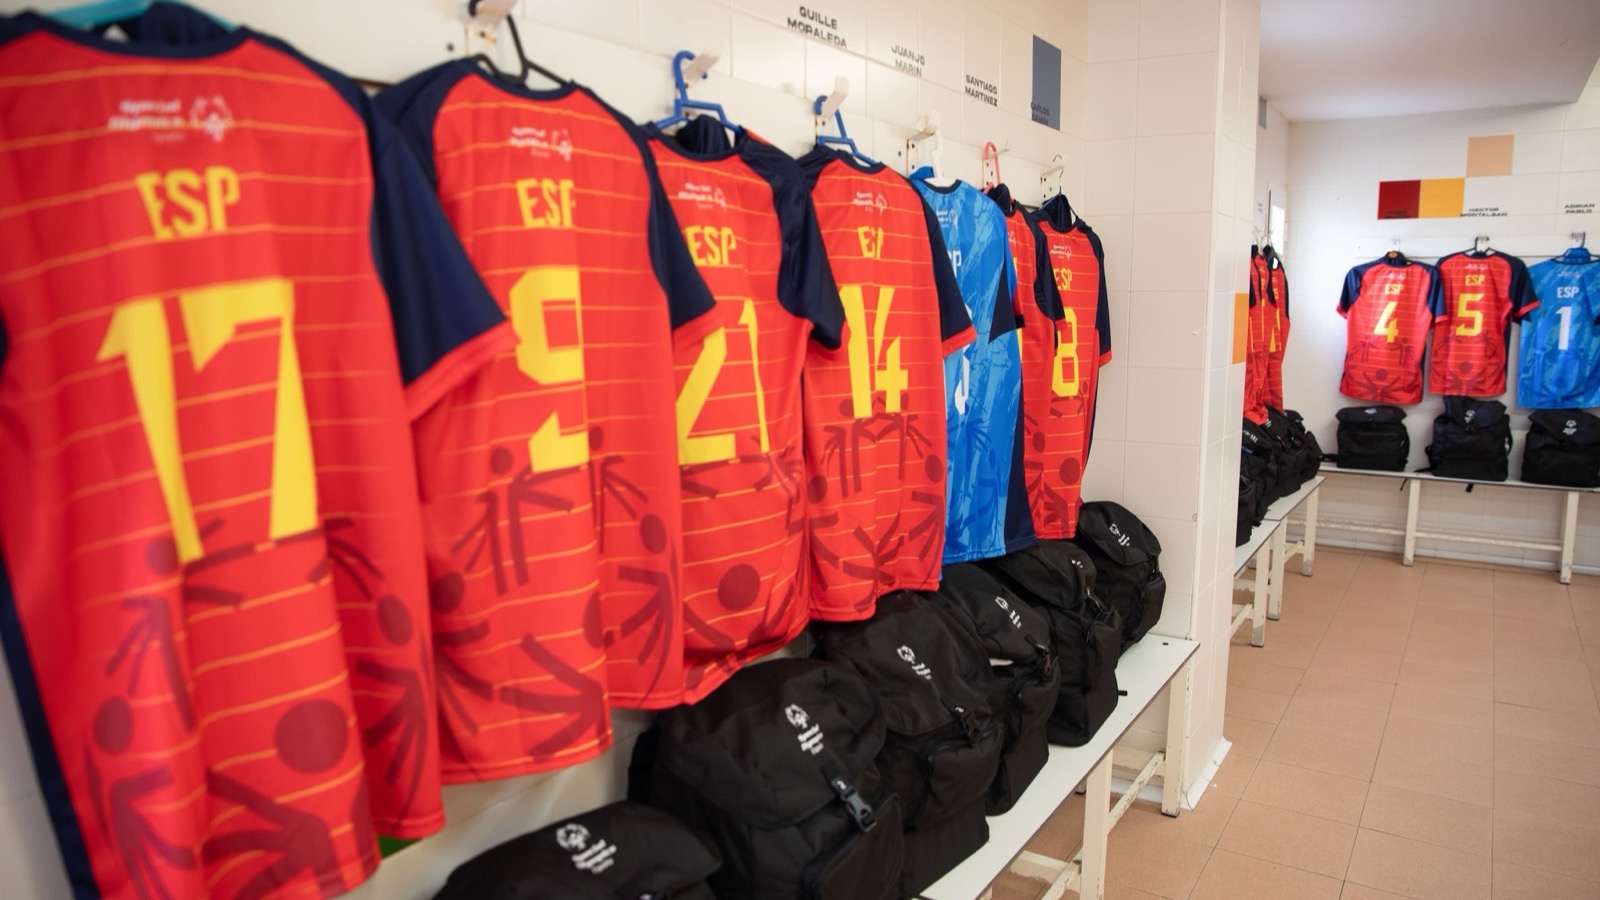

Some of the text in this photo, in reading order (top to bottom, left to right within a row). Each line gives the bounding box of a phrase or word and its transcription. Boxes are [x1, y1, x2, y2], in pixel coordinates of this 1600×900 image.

[787, 16, 847, 47] MORALEDA
[891, 44, 925, 66] JUANJO
[965, 74, 998, 95] SANTIAGO
[965, 86, 998, 107] MARTINEZ
[135, 165, 241, 241] ESP
[686, 225, 737, 267] ESP
[1384, 283, 1405, 295] ESP
[1464, 274, 1486, 286] ESP
[1556, 286, 1580, 299] ESP
[1372, 301, 1399, 343] 4
[1455, 293, 1485, 337] 5
[1555, 305, 1572, 351] 1
[1051, 306, 1080, 398] 8
[96, 277, 319, 565] 17
